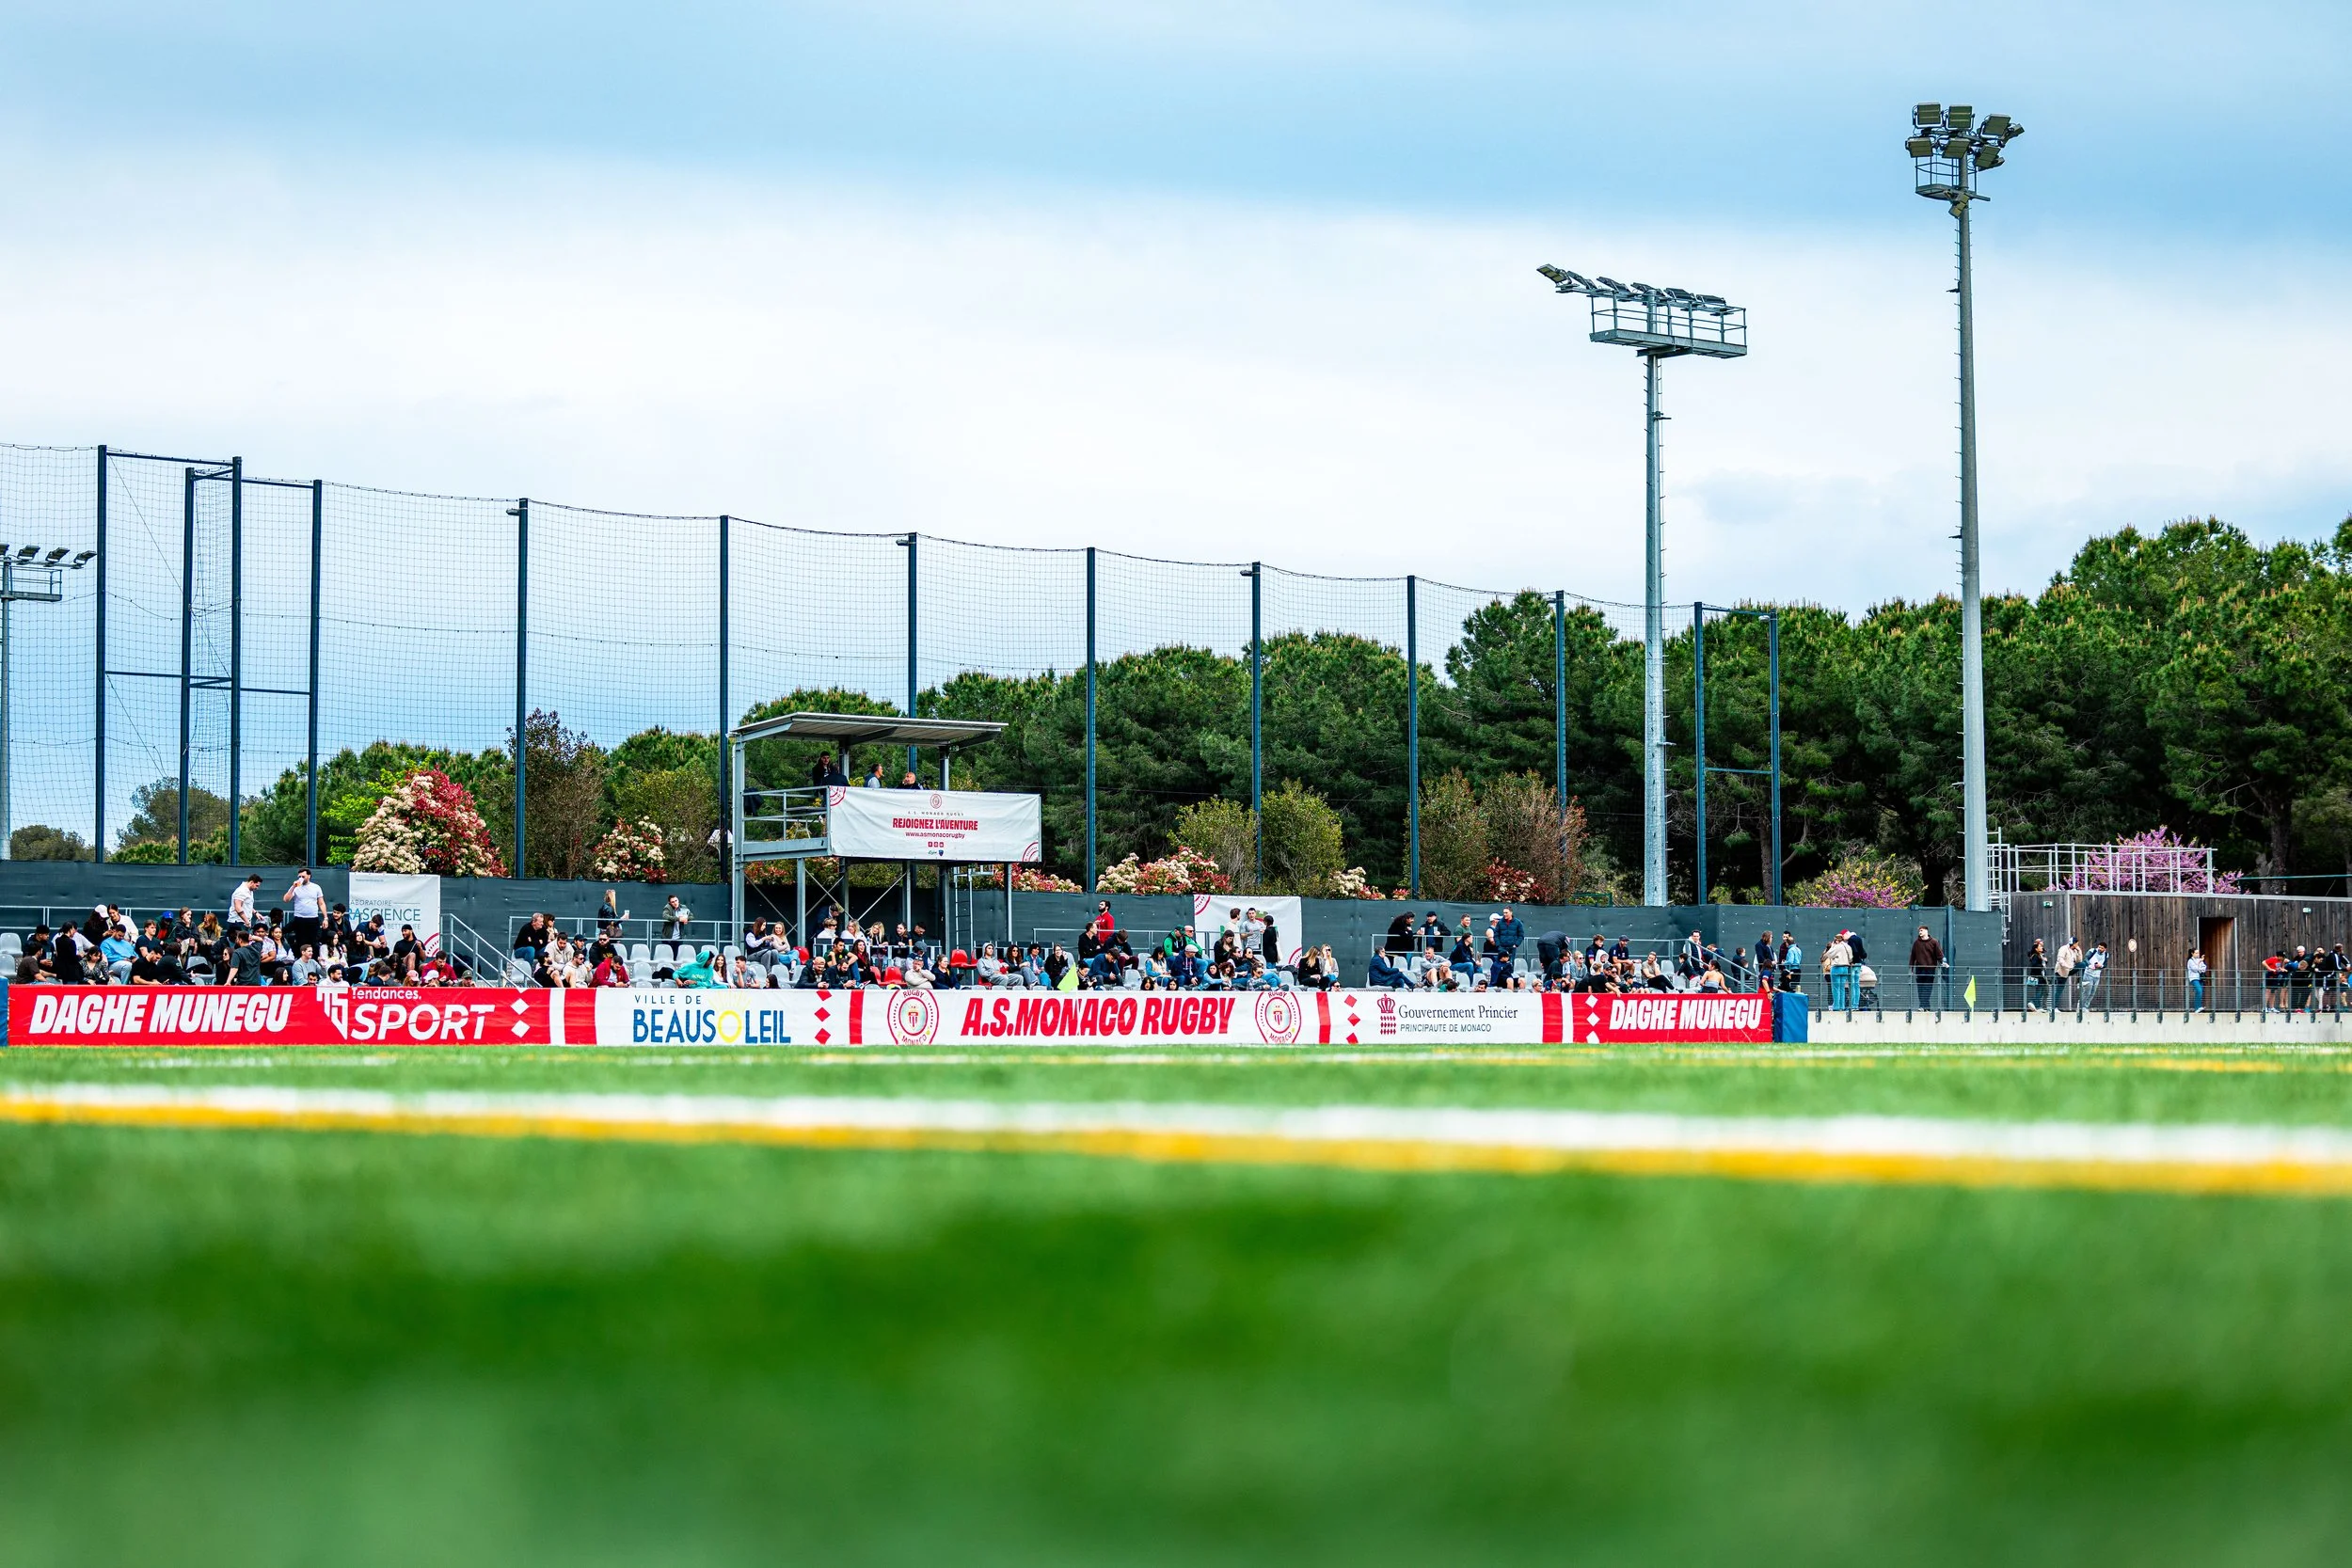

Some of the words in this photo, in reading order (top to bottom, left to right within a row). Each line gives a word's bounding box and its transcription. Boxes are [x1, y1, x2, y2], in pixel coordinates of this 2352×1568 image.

[893, 818, 933, 830] REJOIGNEZ
[935, 819, 978, 831] L'AVENTURE
[351, 988, 421, 999] Tendances.
[634, 995, 675, 1004] VILLE
[686, 995, 702, 1004] DE
[28, 994, 149, 1034] DAGHE
[149, 993, 294, 1033] MUNEGU
[350, 1003, 495, 1040] SPORT
[961, 997, 1137, 1037] A.S.MONACO
[1140, 997, 1235, 1035] RUGBY
[1398, 1005, 1476, 1019] Gouvernement
[1478, 1005, 1518, 1019] Princier
[1609, 999, 1678, 1030] DAGHE
[1678, 999, 1764, 1030] MUNEGU
[633, 1009, 791, 1043] BEAUSOLEIL
[1400, 1023, 1447, 1033] PRINCIPAUTE
[1449, 1024, 1458, 1033] DE
[1461, 1024, 1492, 1033] MONACO
